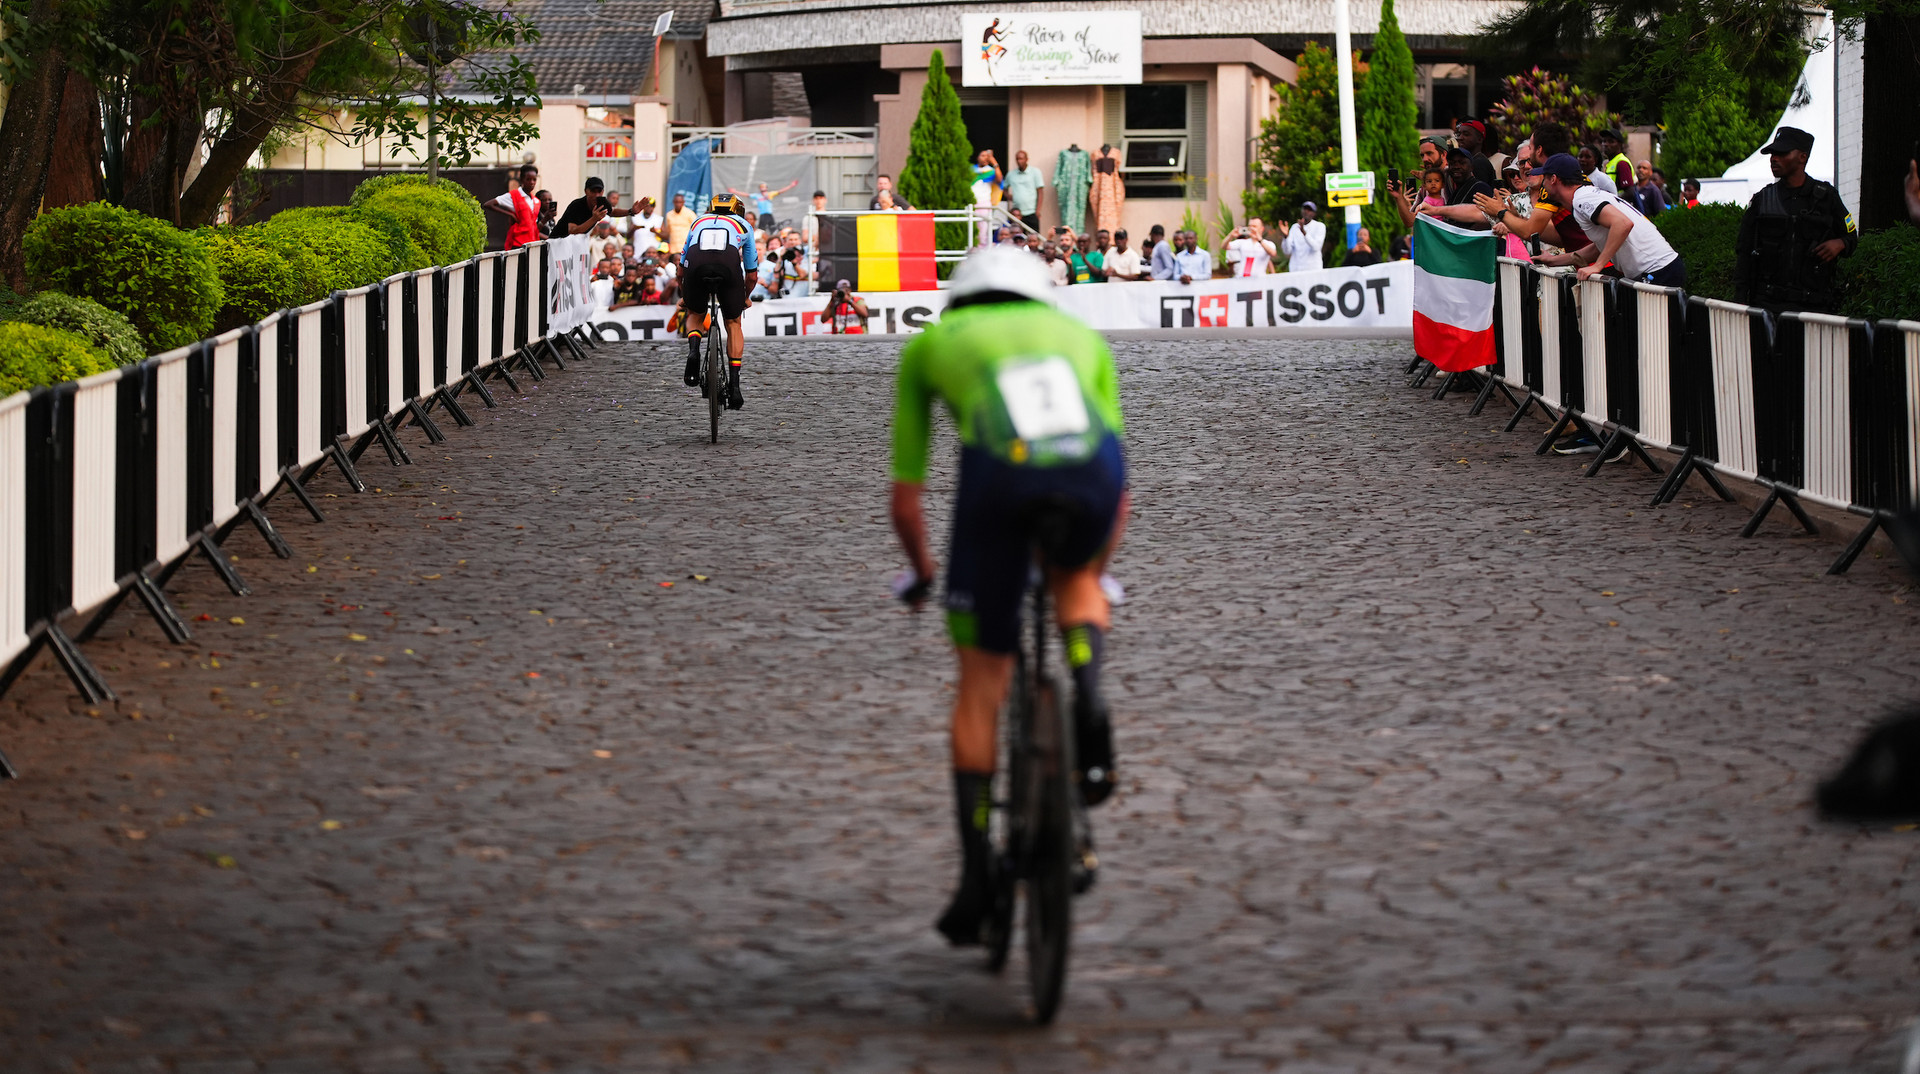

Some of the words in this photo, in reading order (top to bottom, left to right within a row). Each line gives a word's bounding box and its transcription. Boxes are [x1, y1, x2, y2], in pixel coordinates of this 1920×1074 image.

[1024, 23, 1065, 45] River
[1074, 25, 1090, 48] of
[1080, 44, 1120, 65] Store
[1236, 278, 1390, 327] TISSOT
